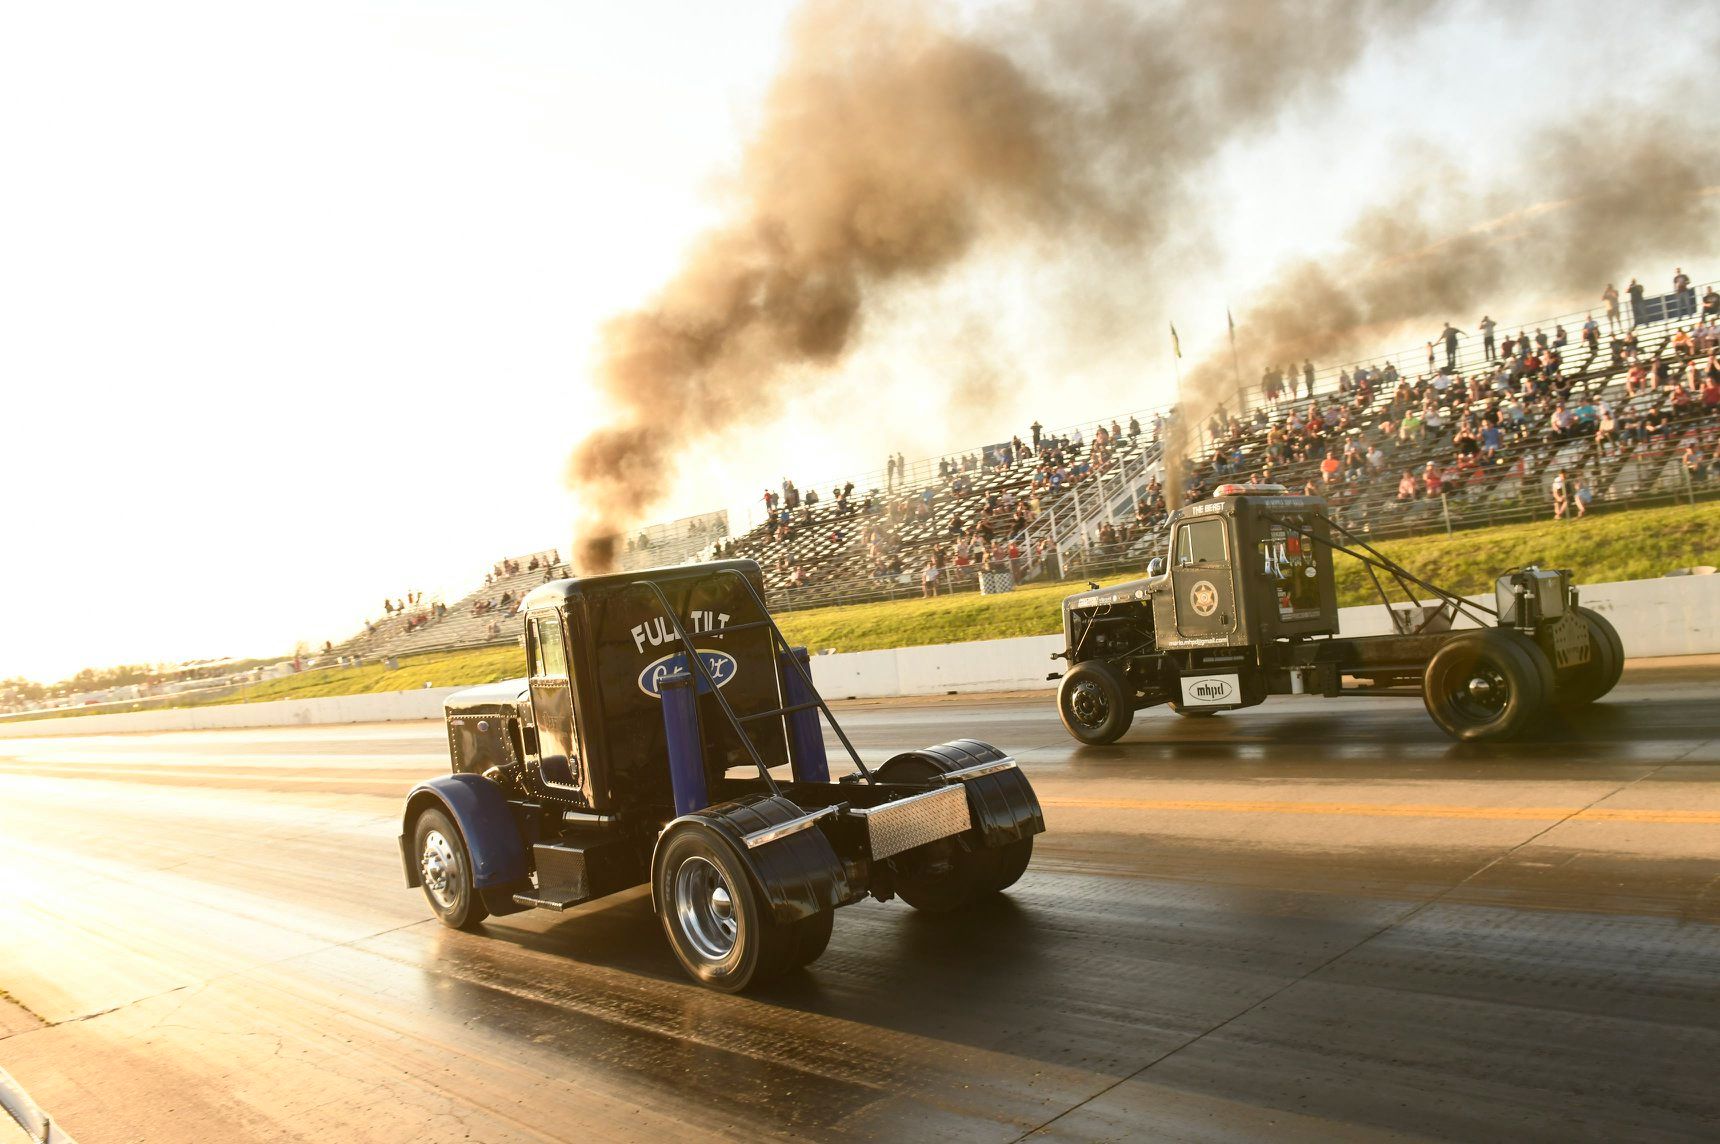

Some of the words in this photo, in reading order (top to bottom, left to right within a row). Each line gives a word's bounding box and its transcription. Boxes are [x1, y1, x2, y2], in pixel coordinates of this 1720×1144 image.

[1192, 505, 1204, 515] THE
[1205, 501, 1225, 512] BEAST
[690, 610, 731, 640] TILT
[1197, 683, 1224, 698] mhpd
